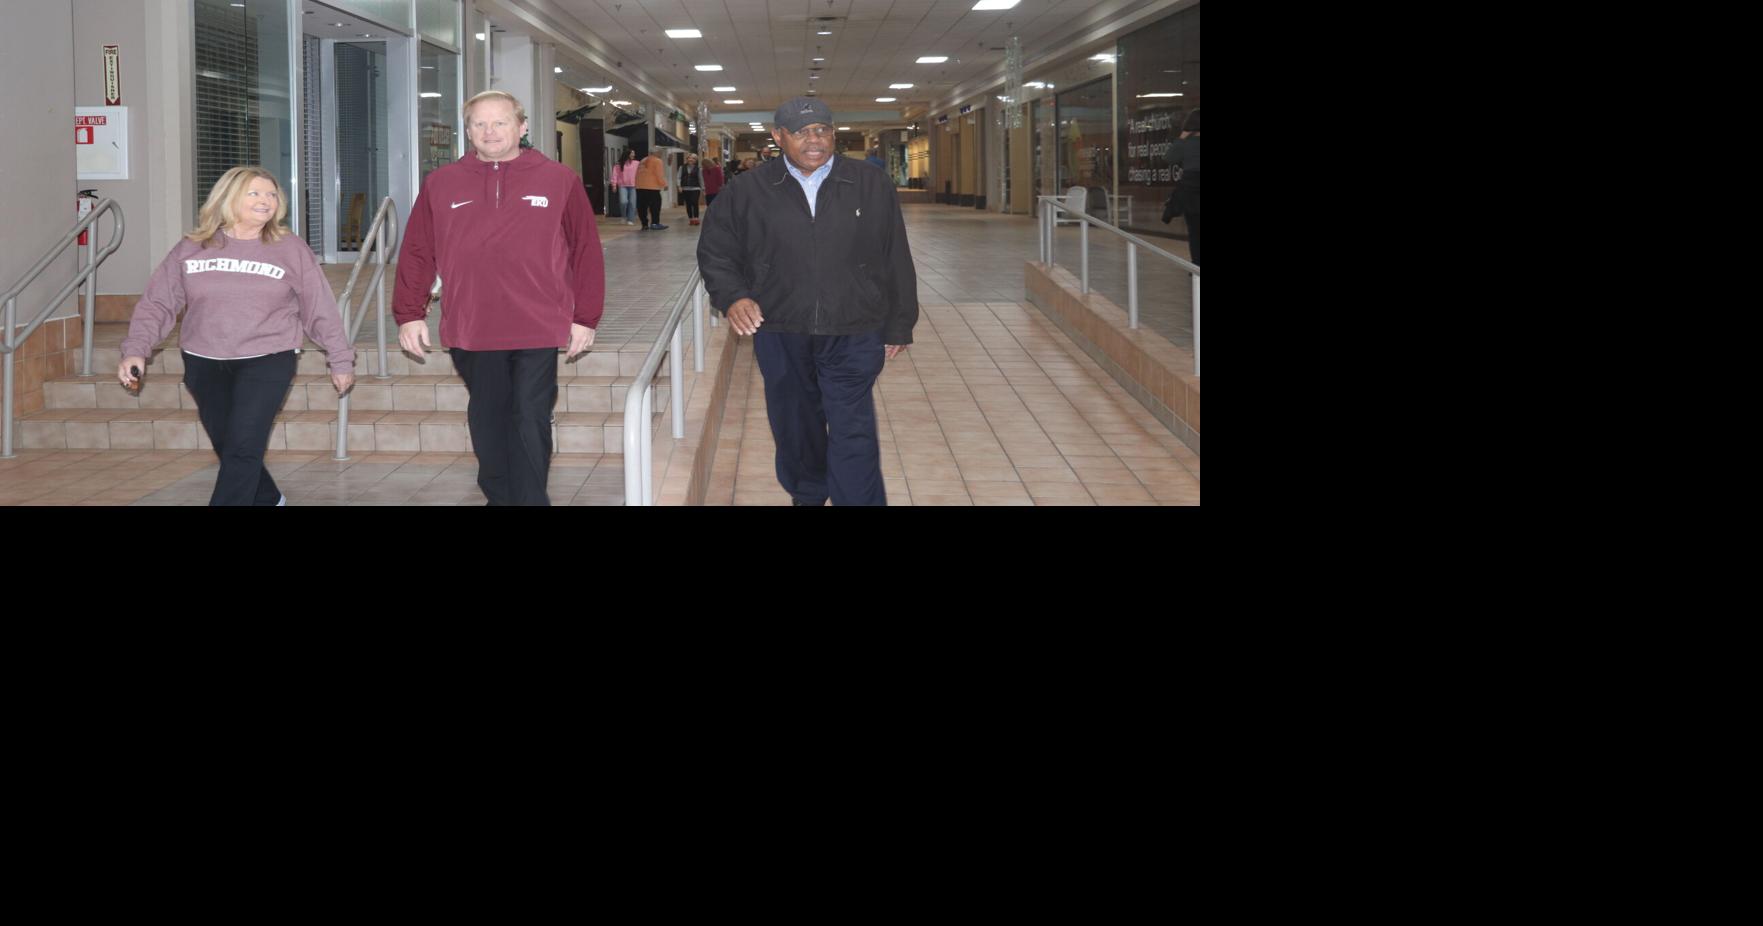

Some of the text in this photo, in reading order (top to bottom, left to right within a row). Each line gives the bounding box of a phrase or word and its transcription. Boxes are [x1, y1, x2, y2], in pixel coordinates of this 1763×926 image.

[88, 116, 105, 125] VALVE
[1128, 141, 1136, 158] for
[1137, 138, 1149, 158] real
[1152, 168, 1157, 182] a
[1158, 164, 1171, 182] real
[185, 257, 286, 280] RICHMOND
